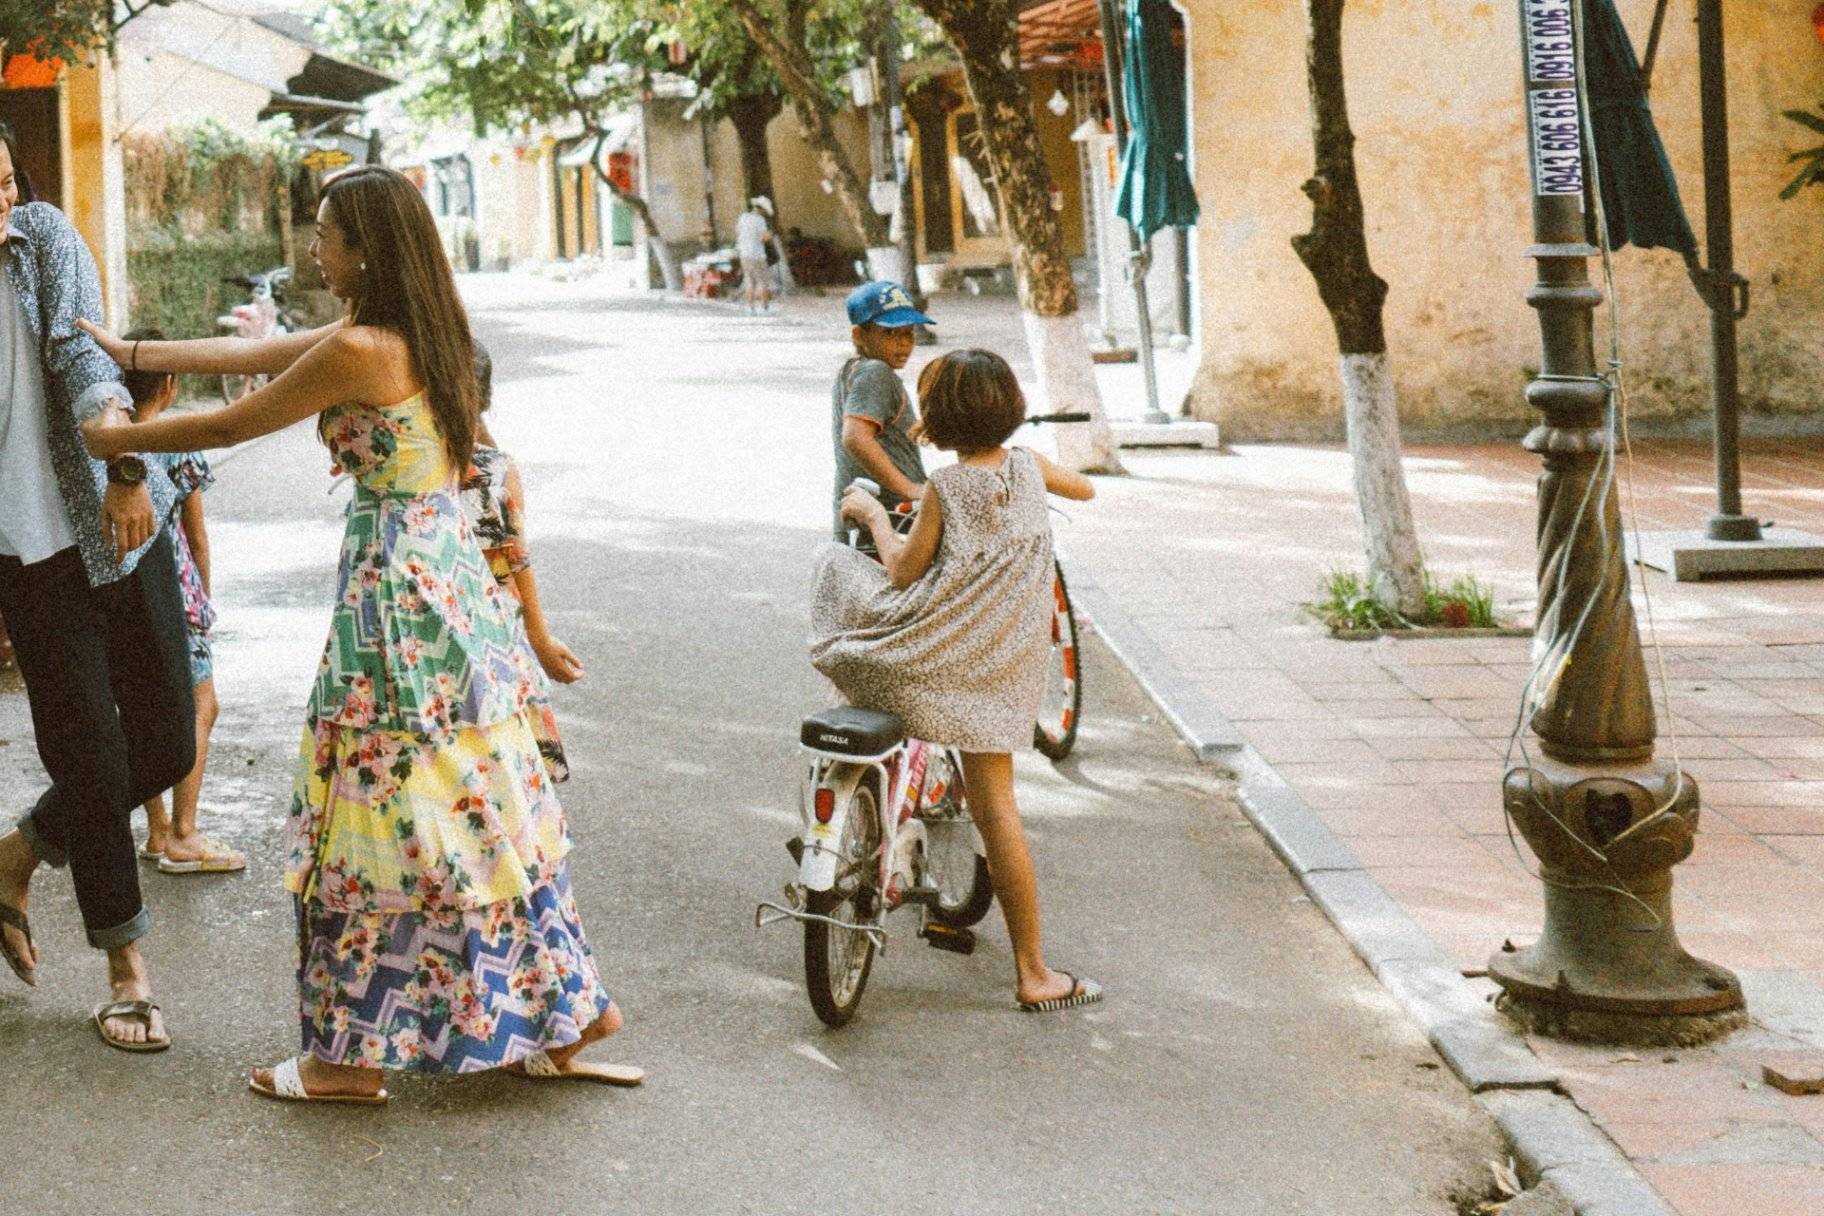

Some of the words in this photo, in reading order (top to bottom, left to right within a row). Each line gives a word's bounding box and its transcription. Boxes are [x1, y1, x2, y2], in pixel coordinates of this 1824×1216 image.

[1531, 8, 1570, 36] 006
[1534, 42, 1574, 79] 0916
[1537, 90, 1576, 118] 616
[1539, 123, 1579, 151] 606
[1543, 156, 1584, 193] 0943
